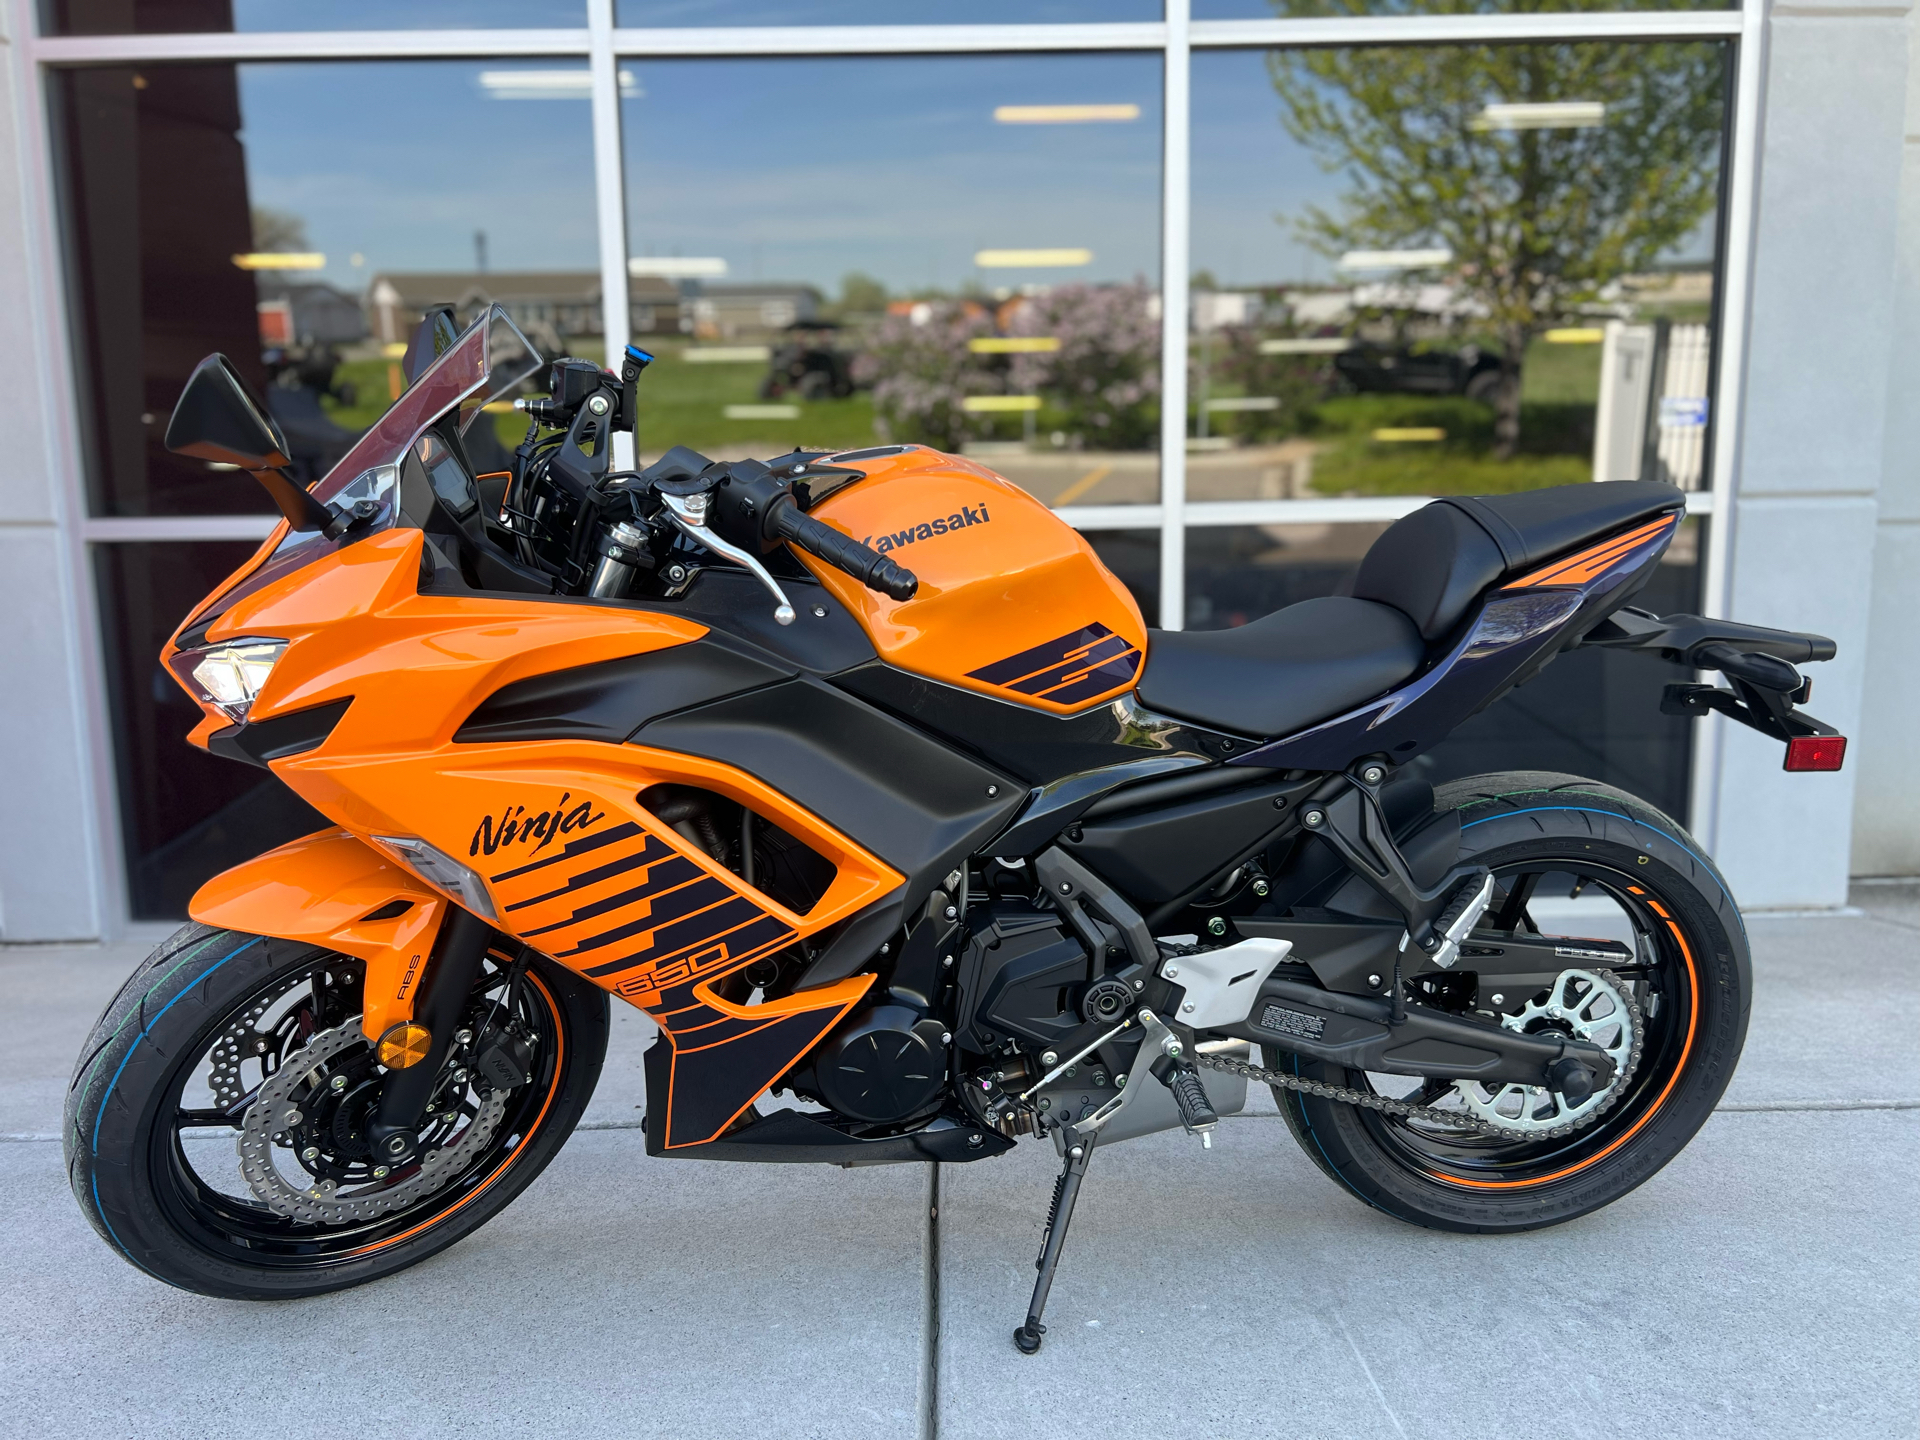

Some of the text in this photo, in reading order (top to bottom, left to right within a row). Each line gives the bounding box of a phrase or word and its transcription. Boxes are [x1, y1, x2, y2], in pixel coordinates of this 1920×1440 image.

[469, 792, 605, 857] Ninja
[397, 955, 421, 1000] ABS
[616, 942, 730, 996] 650
